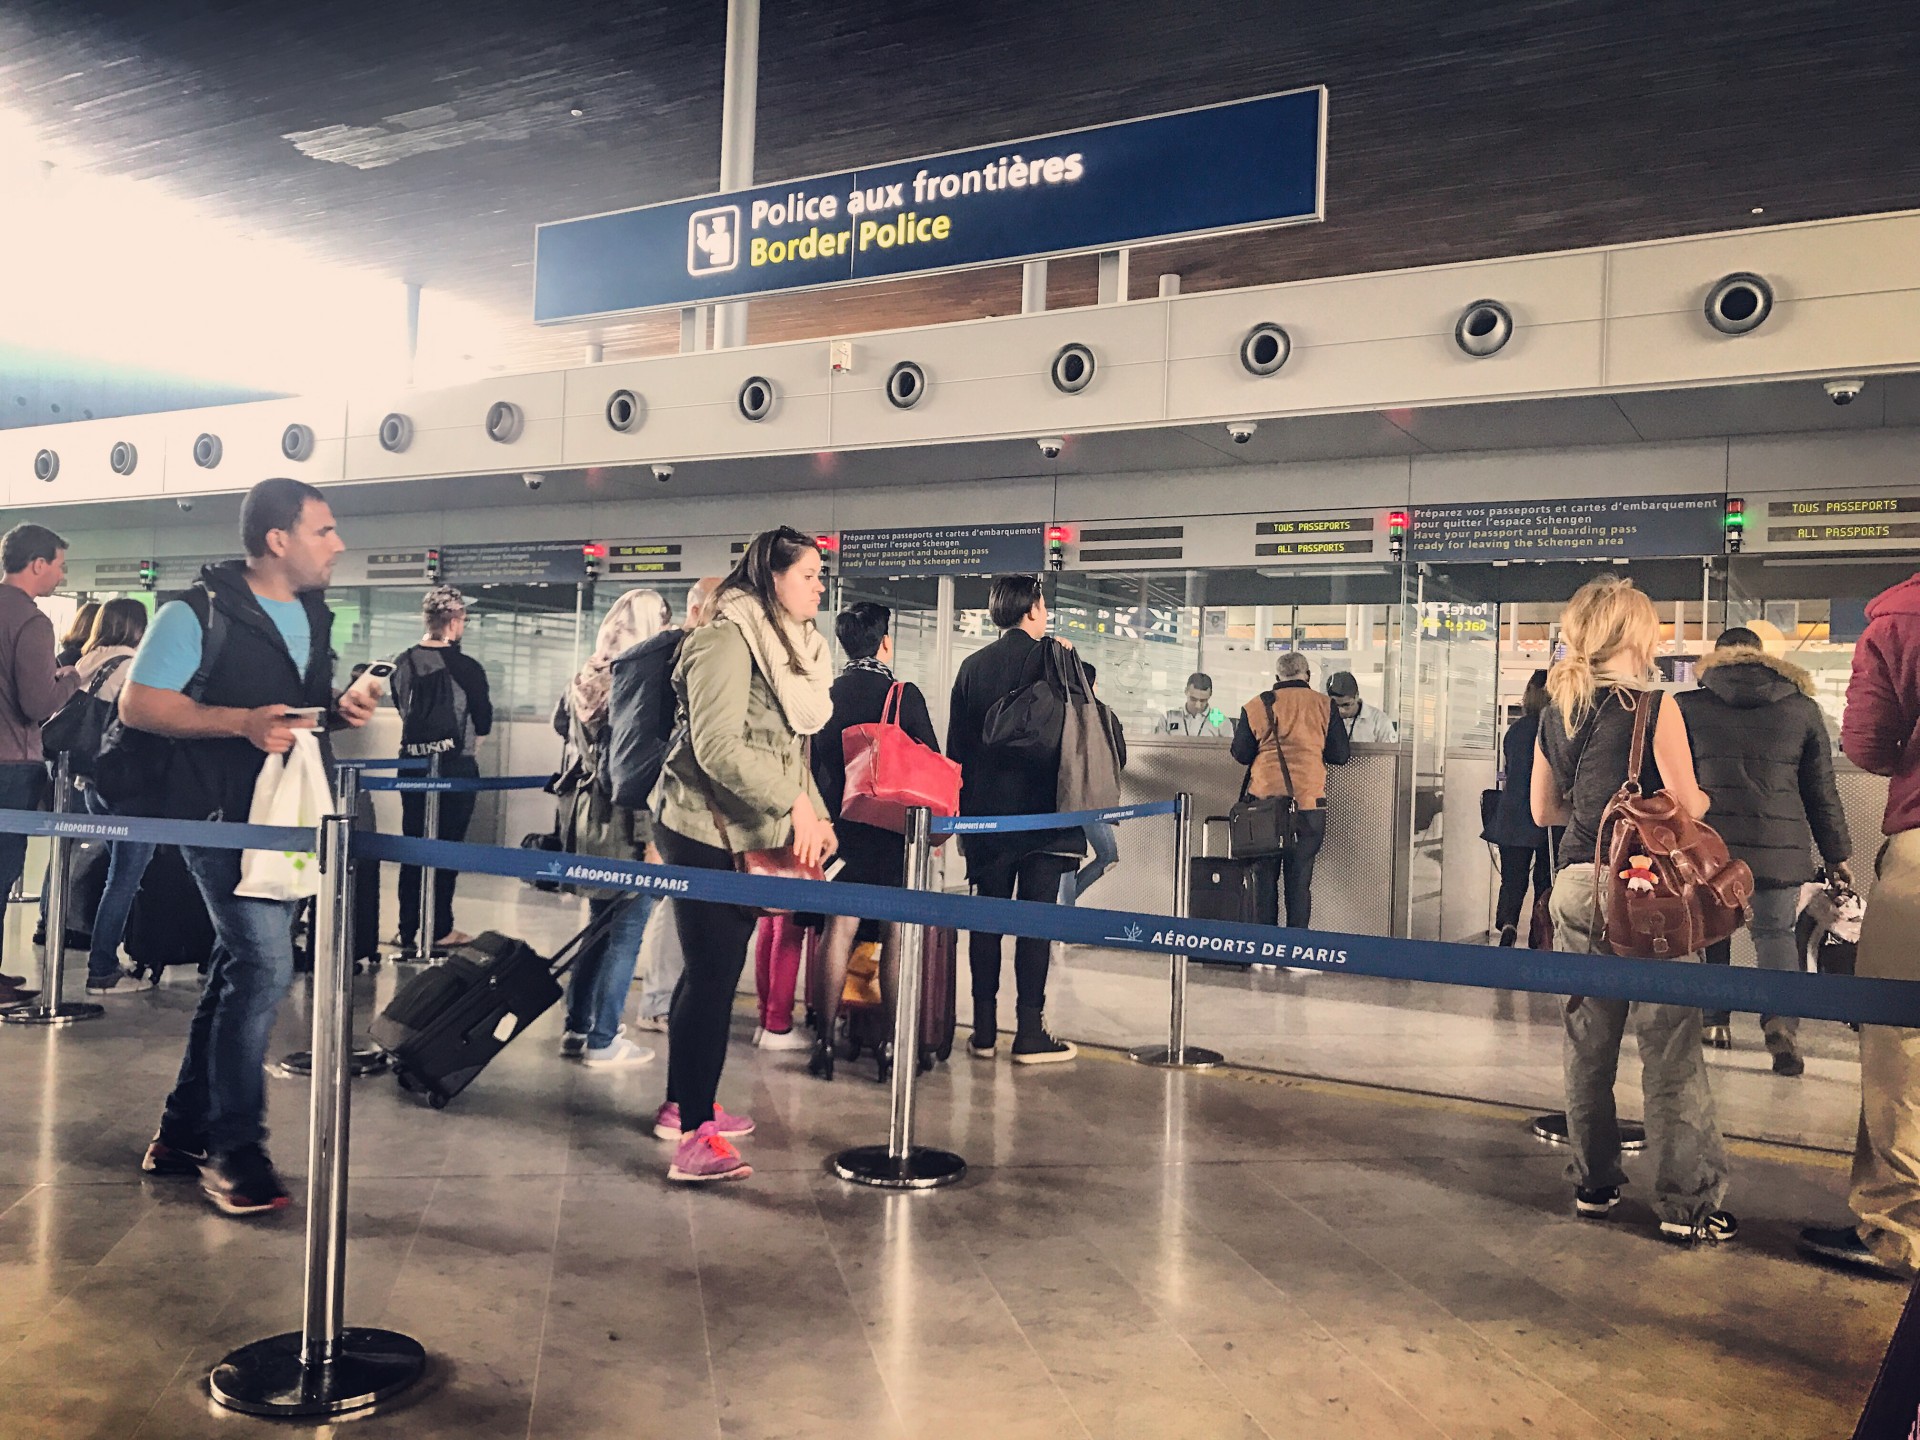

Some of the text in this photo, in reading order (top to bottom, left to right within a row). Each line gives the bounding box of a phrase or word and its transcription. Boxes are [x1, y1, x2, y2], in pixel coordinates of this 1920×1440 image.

[751, 152, 1084, 230] Police aux frontières
[750, 212, 951, 267] Border Police
[1414, 508, 1462, 519] Préparez
[1489, 505, 1551, 516] passeports
[1555, 505, 1567, 513] et
[1571, 504, 1607, 513] cartes
[1792, 500, 1898, 514] TOUS PASSEPORTS
[1274, 521, 1351, 532] TOUS PASSEPORTS
[1414, 521, 1439, 530] pour
[1443, 519, 1482, 529] quitter
[1536, 515, 1592, 526] Schengen
[843, 533, 874, 542] Préparez
[892, 532, 933, 541] passeports
[1414, 525, 1638, 540] Have your passport and boarding pass
[1798, 526, 1890, 538] ALL PASSPORTS
[842, 543, 860, 551] pour
[862, 542, 887, 550] quitter
[923, 539, 960, 547] Schengen
[1277, 543, 1345, 553] ALL PASSPORTS
[1414, 537, 1624, 551] ready for leaving the Schengen area
[882, 550, 915, 558] passport
[934, 548, 969, 556] boarding
[971, 548, 989, 556] pass
[879, 558, 906, 567] leaving
[908, 557, 921, 565] the
[923, 557, 960, 566] Schengen
[407, 737, 455, 756] HUDSON
[54, 822, 129, 836] AÉROPORTS DE PARIS
[565, 864, 690, 892] AÉROPORTS DE PARIS
[1150, 930, 1348, 964] AÉROPORTS DE PARIS
